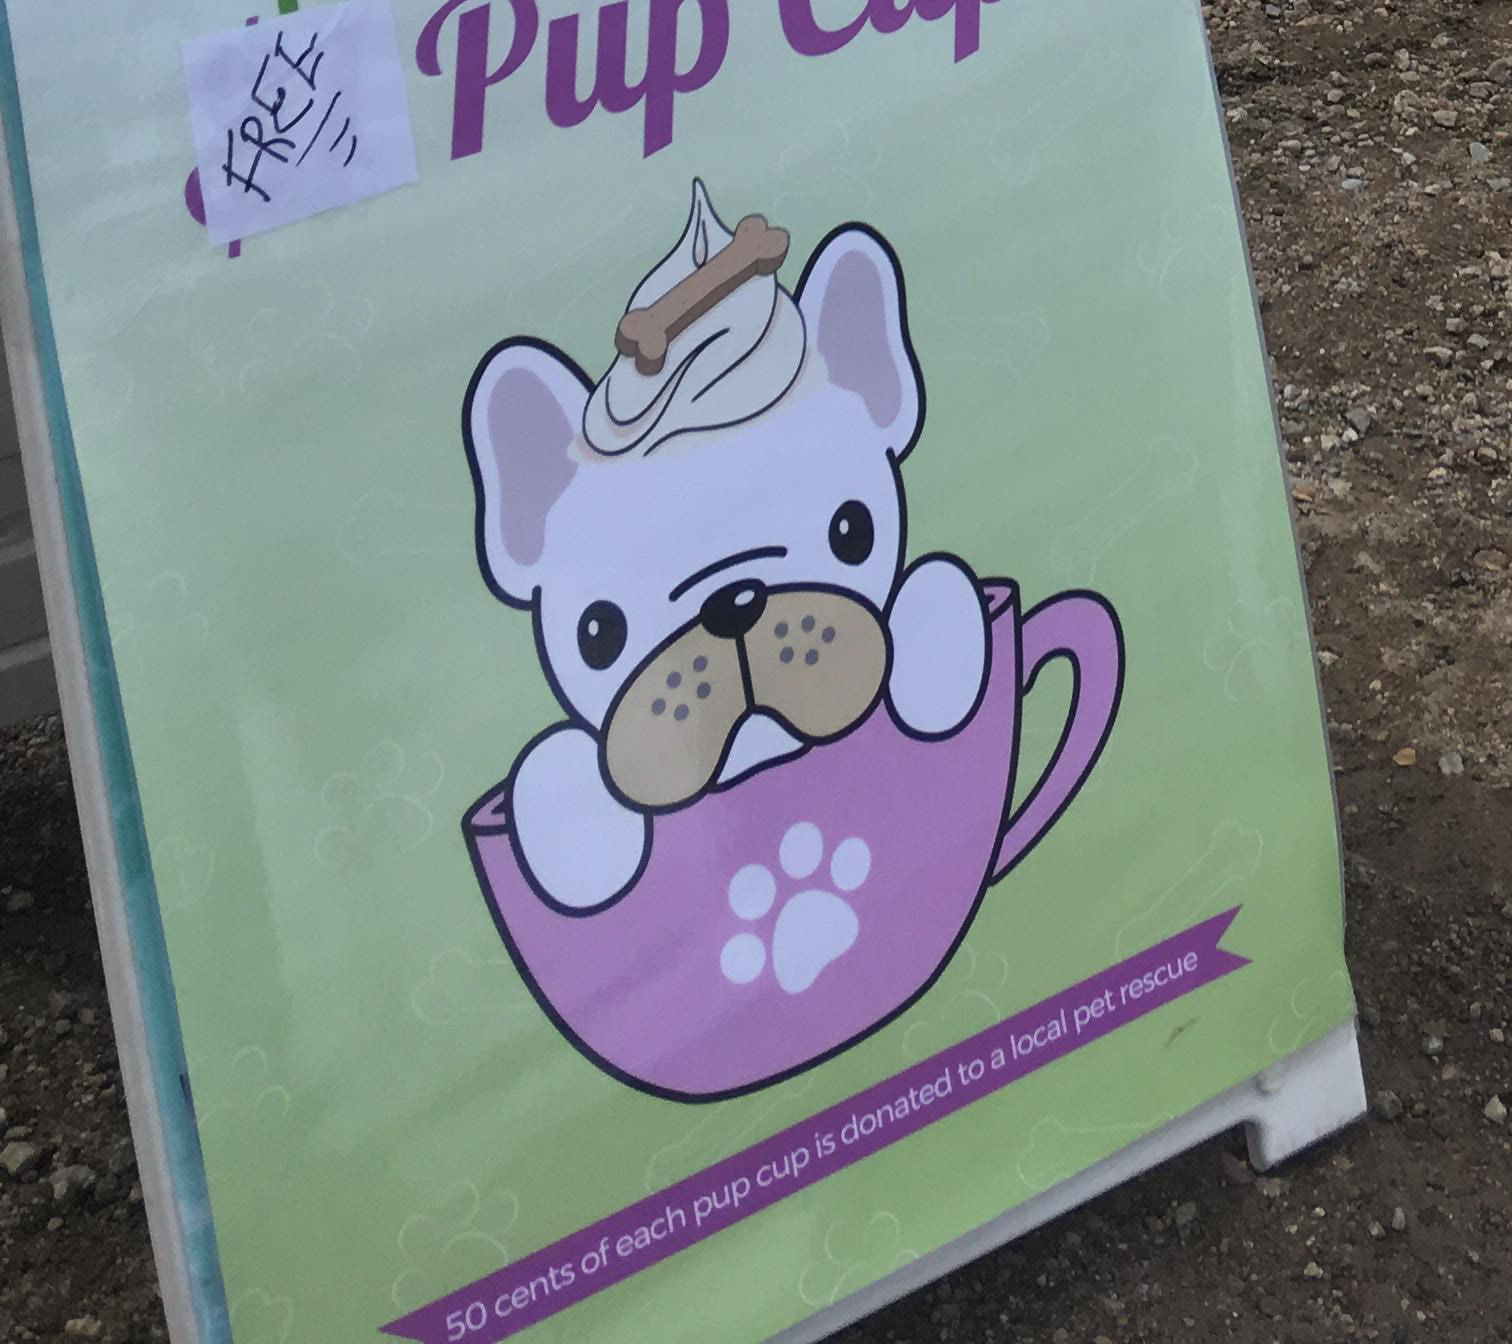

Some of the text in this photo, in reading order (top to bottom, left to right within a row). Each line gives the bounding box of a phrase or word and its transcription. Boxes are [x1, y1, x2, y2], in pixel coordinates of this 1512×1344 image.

[222, 30, 324, 202] FREE
[445, 950, 1199, 1342] 50 cents of each pup cup is donated to a local pet rescue
